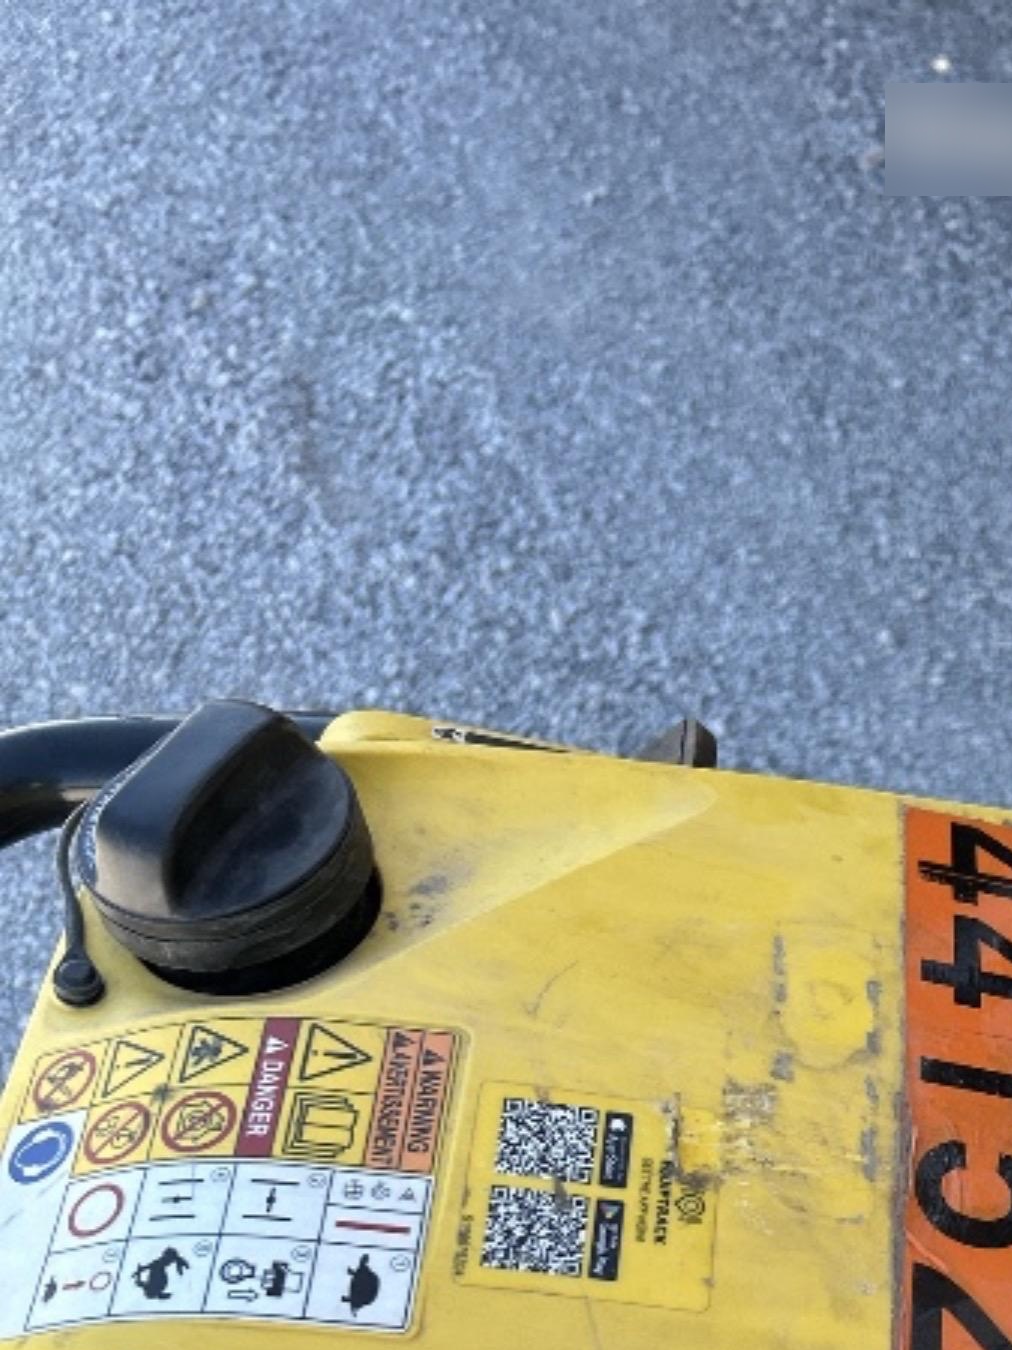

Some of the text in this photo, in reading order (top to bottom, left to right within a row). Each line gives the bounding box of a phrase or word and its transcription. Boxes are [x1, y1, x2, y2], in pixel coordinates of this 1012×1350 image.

[245, 1061, 286, 1137] DANGER
[371, 1052, 411, 1165] AVERTISSEMENT
[407, 1070, 442, 1153] WARNING
